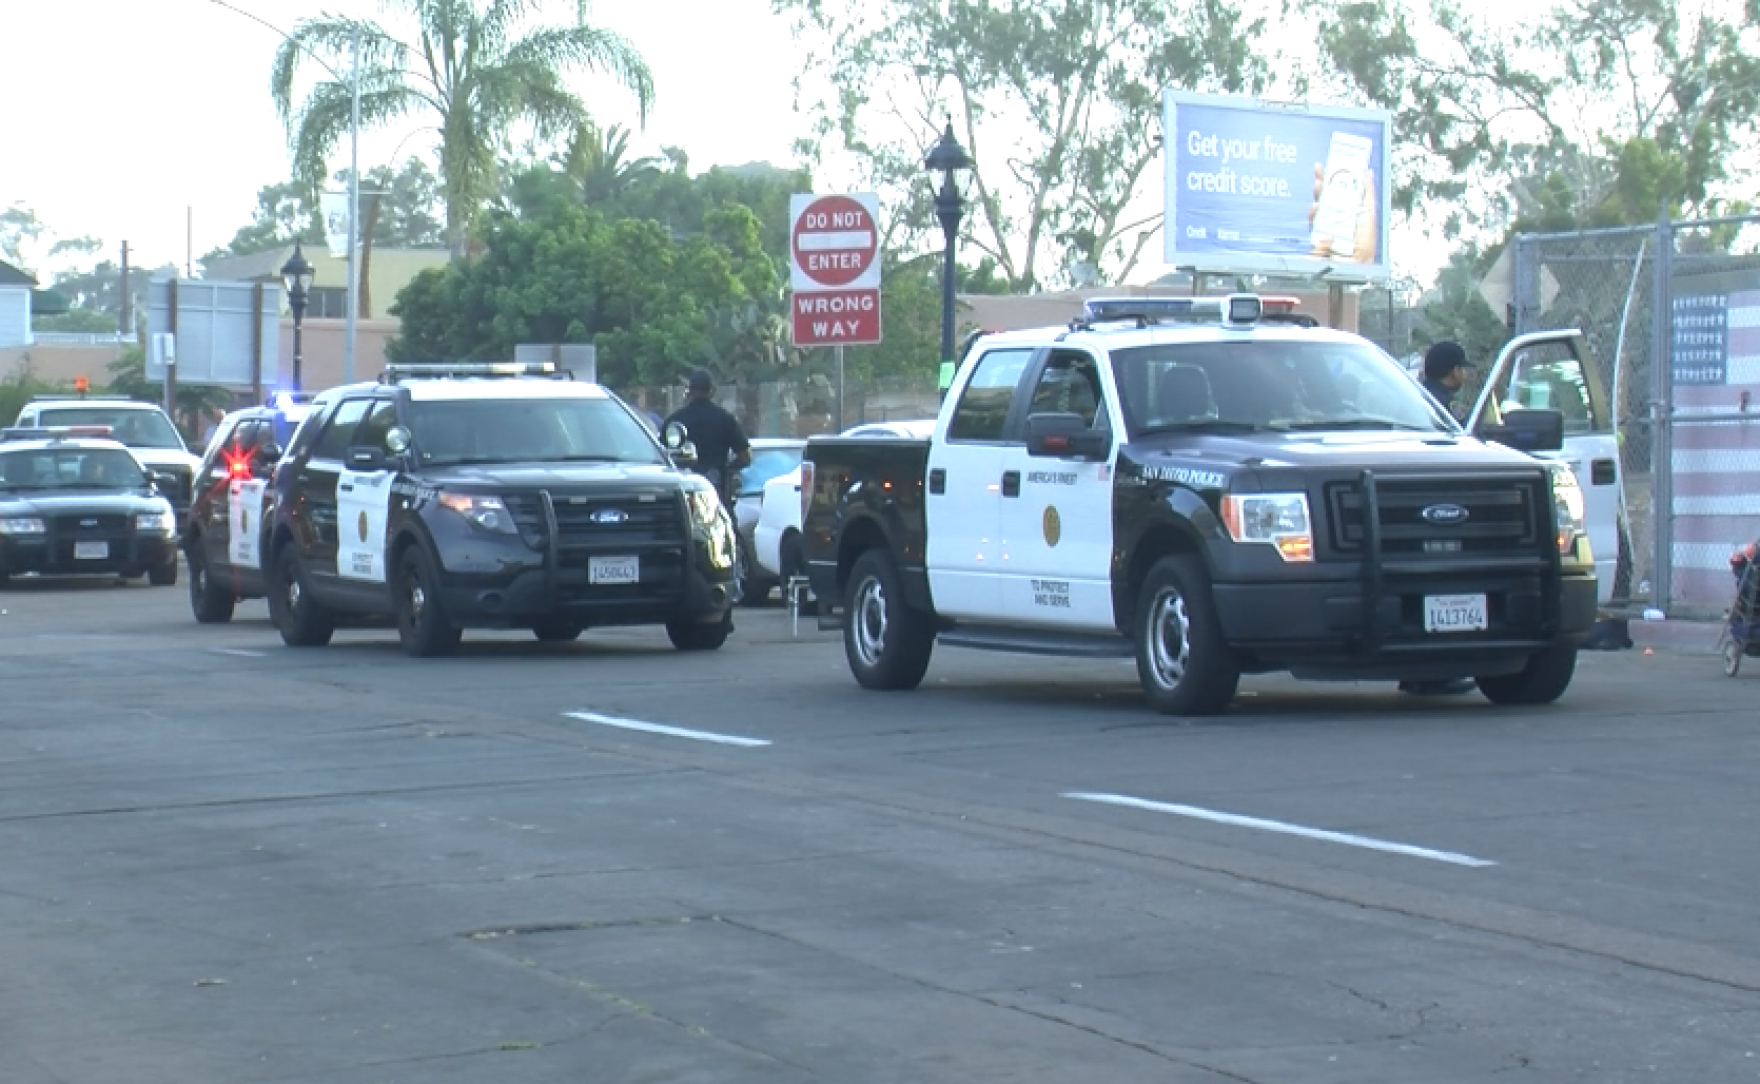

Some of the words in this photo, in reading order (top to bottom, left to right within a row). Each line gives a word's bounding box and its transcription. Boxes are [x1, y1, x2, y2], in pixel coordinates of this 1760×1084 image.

[1187, 130, 1218, 157] Get
[1221, 137, 1261, 164] your
[1263, 135, 1297, 163] free
[1187, 167, 1238, 195] credit
[1240, 175, 1293, 198] score.
[806, 212, 828, 229] DO
[832, 211, 863, 228] NOT
[808, 252, 862, 271] ENTER
[798, 294, 874, 315] WRONG
[812, 319, 861, 338] WAY
